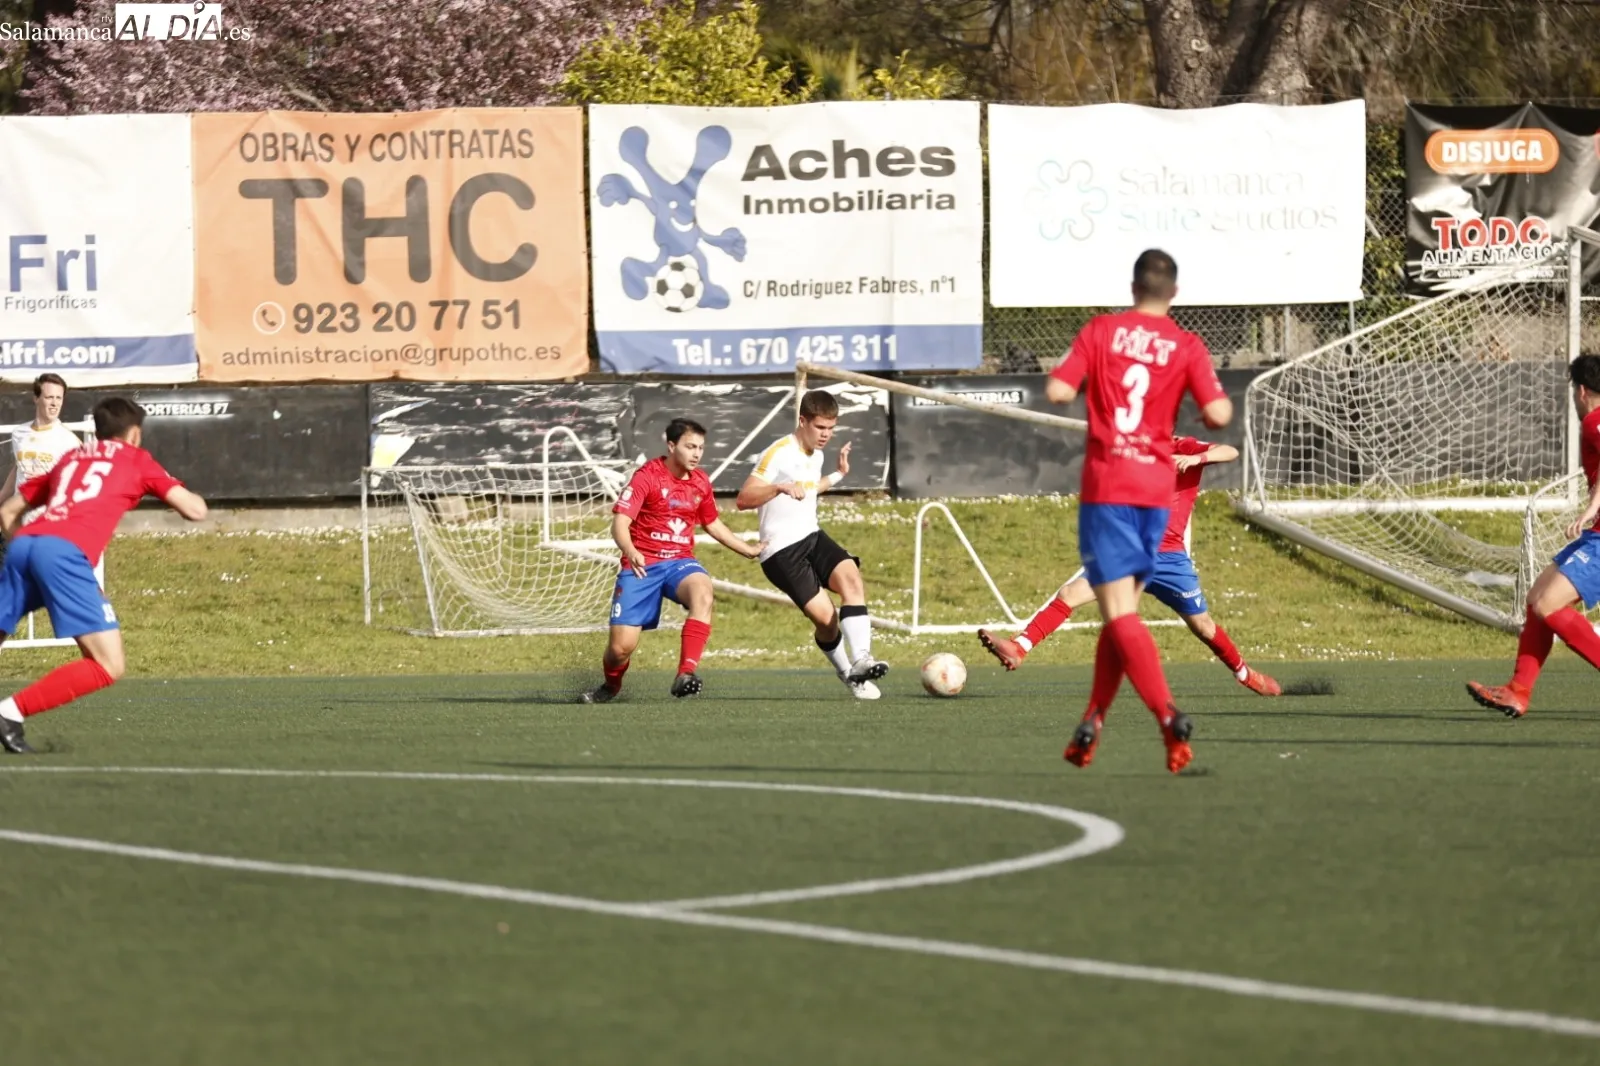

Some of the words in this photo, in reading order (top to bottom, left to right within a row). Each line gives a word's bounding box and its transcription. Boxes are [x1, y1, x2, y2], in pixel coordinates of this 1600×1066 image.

[240, 131, 335, 163] OBRAS
[344, 132, 364, 161] Y
[369, 128, 535, 162] CONTRATAS
[741, 140, 956, 181] Aches
[1442, 140, 1544, 164] DISJUGA
[743, 189, 956, 215] Inmobiliaria
[238, 172, 539, 286] THC
[1432, 216, 1551, 251] TODO
[9, 234, 97, 292] Fri
[743, 280, 761, 299] C/
[859, 276, 925, 297] Fabres,
[293, 301, 361, 334] 923
[372, 301, 417, 333] 20
[429, 299, 471, 332] 77
[481, 299, 523, 331] 51
[0, 340, 116, 365] lfri.com
[222, 343, 561, 369] administracion@grupothc.es
[673, 340, 732, 366] Tel.:
[740, 338, 788, 364] 670
[795, 336, 845, 362] 425
[852, 335, 898, 361] 311
[1114, 363, 1150, 434] 3
[48, 460, 114, 507] 15
